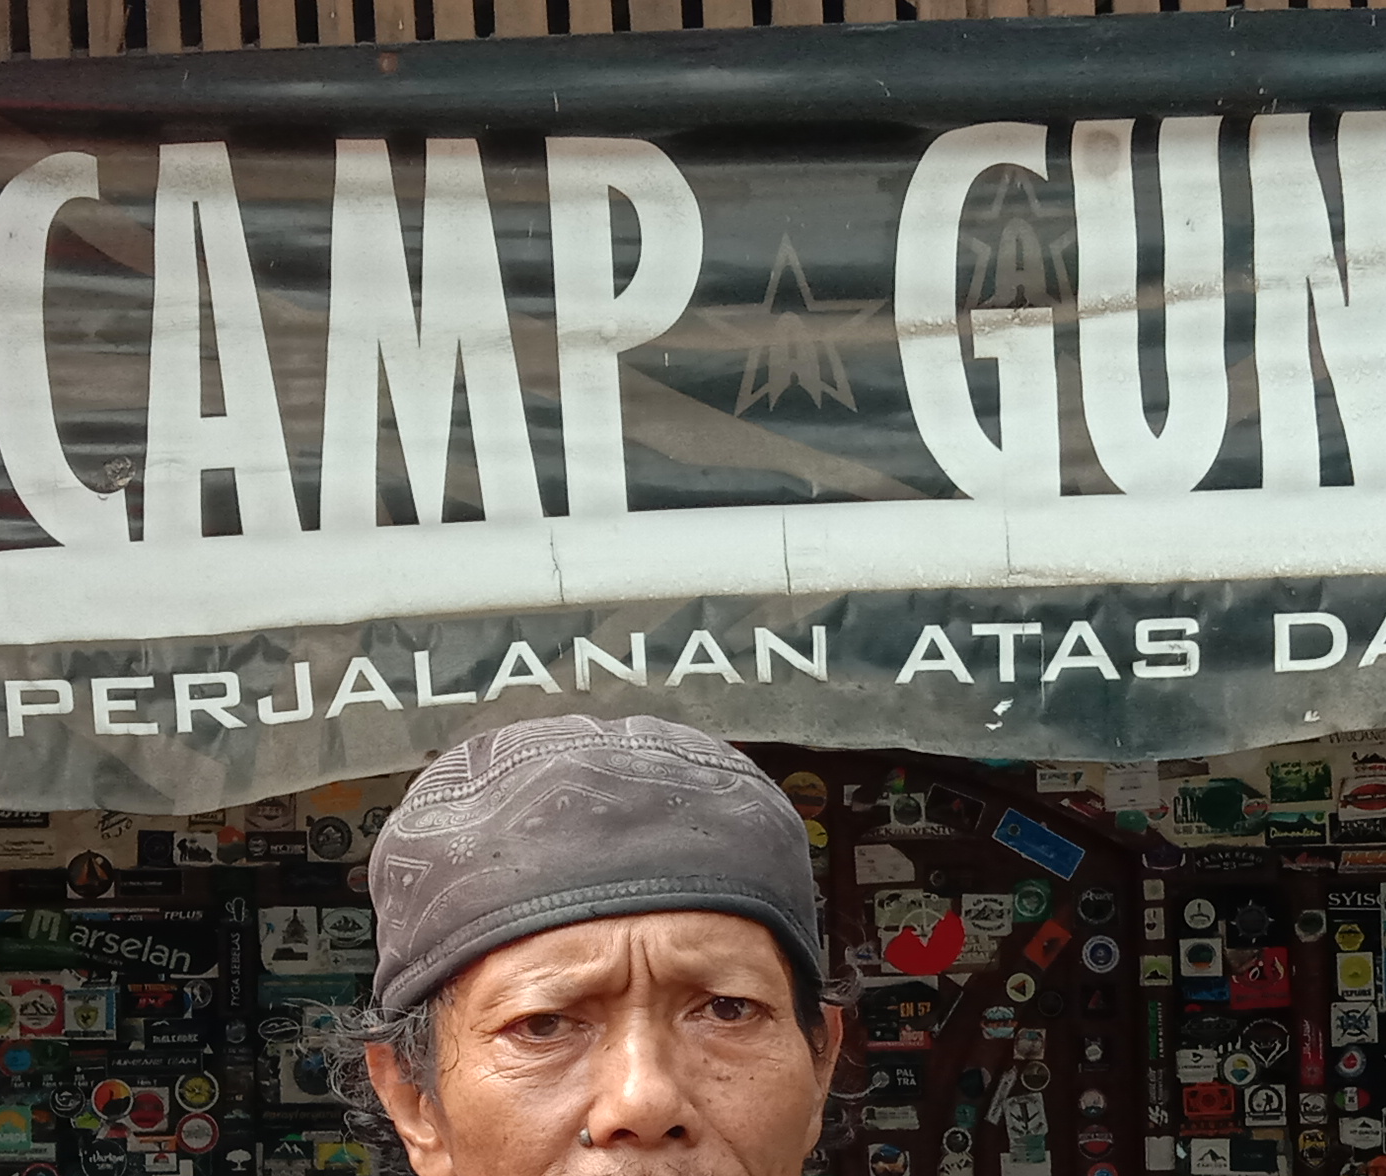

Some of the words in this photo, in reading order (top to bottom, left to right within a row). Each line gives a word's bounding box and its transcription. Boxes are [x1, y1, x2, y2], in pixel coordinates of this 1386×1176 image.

[5, 622, 827, 738] PERJALANAN
[894, 616, 1202, 682] ATAS
[896, 1068, 915, 1078] PAL
[896, 1077, 917, 1086] TRA
